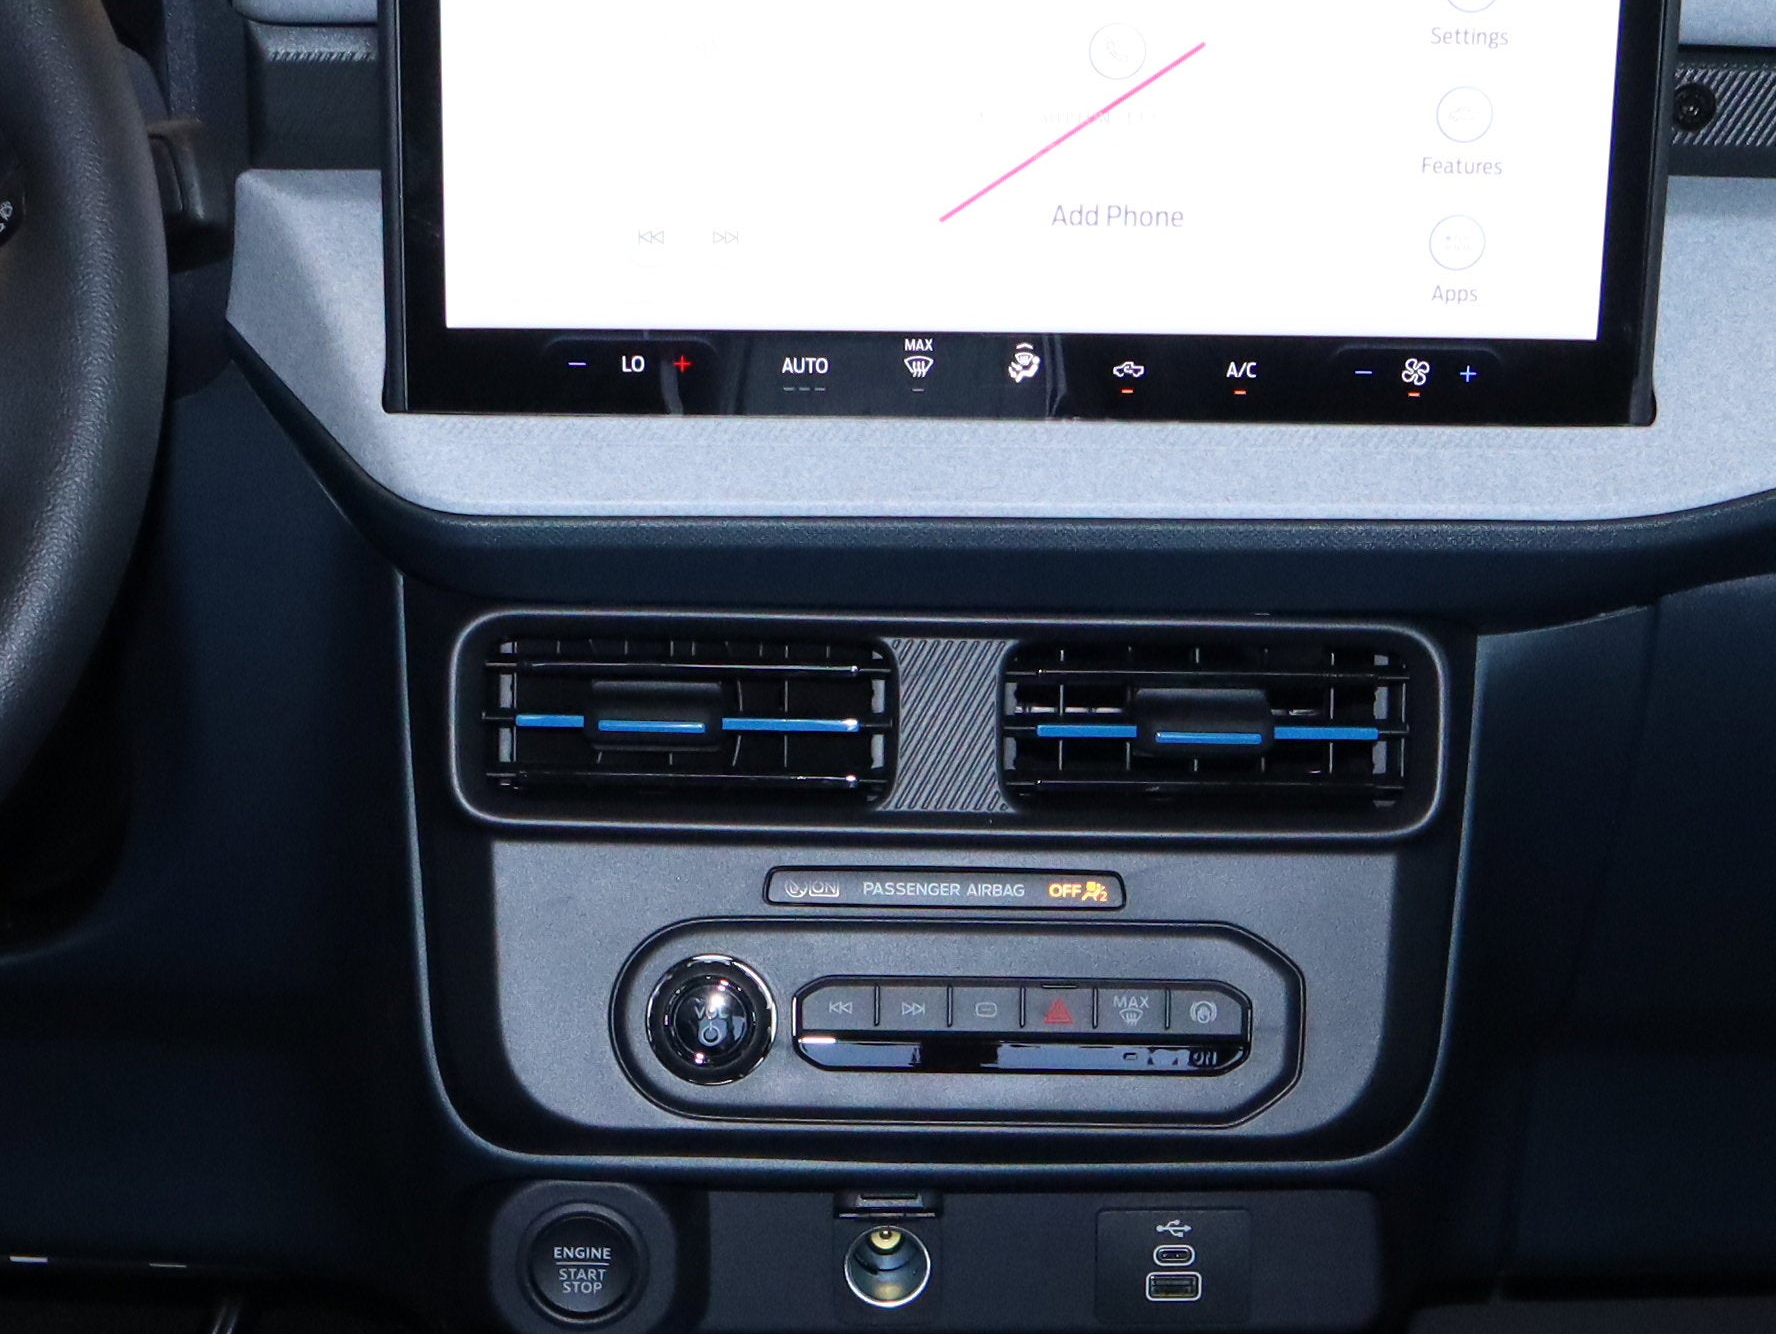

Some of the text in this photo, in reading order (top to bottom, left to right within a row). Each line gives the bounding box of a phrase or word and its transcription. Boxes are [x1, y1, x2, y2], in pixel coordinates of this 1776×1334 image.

[1431, 27, 1509, 49] Settings
[1421, 156, 1503, 175] Features
[1051, 204, 1184, 227] Add Phone
[1431, 284, 1478, 305] Apps
[904, 338, 934, 352] MAX
[621, 355, 645, 373] LO
[781, 357, 829, 374] AUTO
[1226, 361, 1257, 379] A/C
[863, 882, 1025, 897] PASSENGER AIRBAG
[1049, 883, 1082, 898] OFF
[1114, 996, 1149, 1008] MAX
[554, 1246, 611, 1260] ENGINE
[559, 1268, 606, 1281] START
[563, 1281, 602, 1294] STOP
